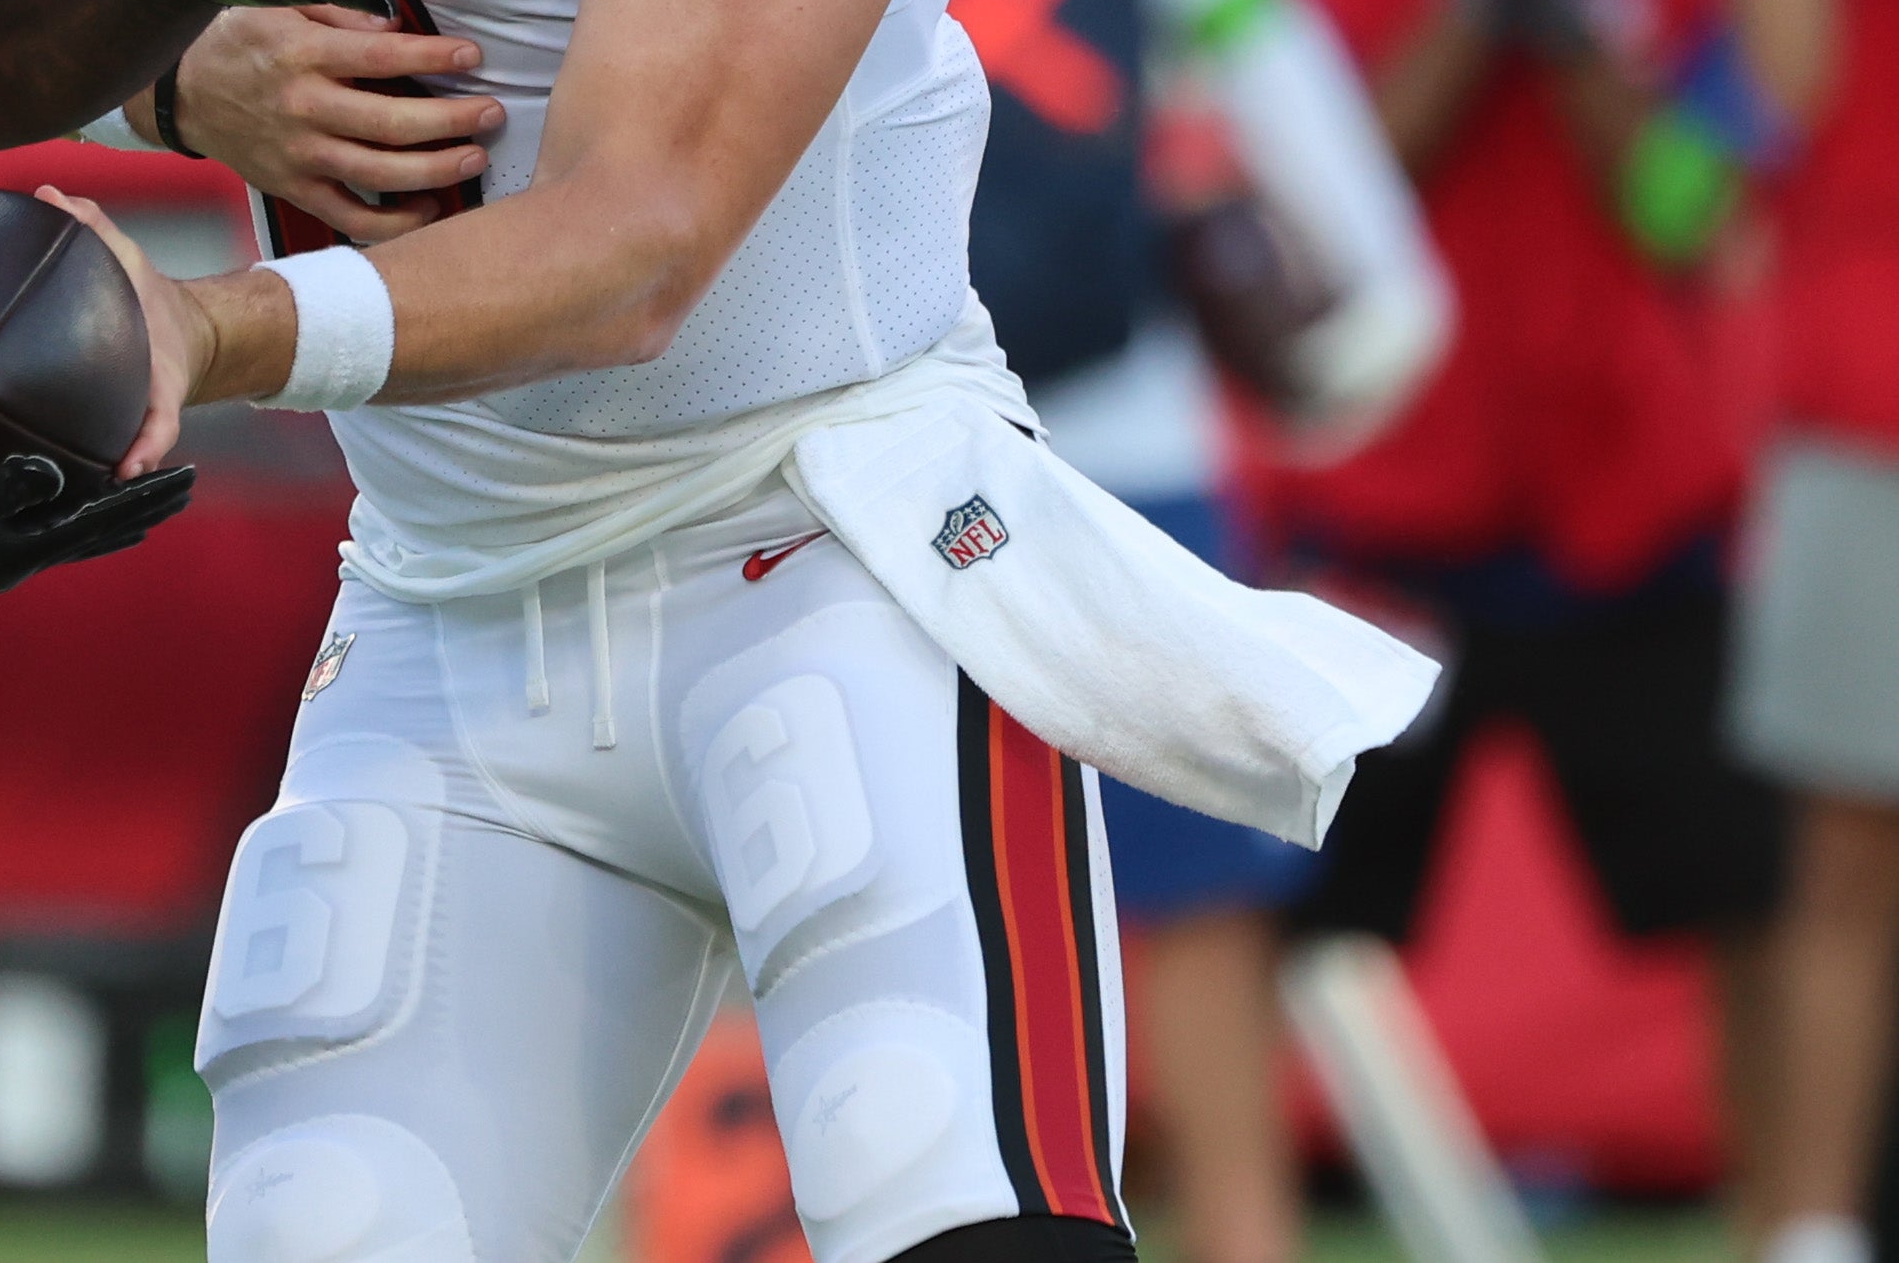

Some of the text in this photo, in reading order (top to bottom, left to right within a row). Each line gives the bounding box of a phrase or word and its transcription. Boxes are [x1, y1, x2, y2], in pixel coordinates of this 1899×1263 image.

[947, 518, 1004, 566] NFL
[212, 801, 346, 1021] 6
[701, 705, 815, 933] 6
